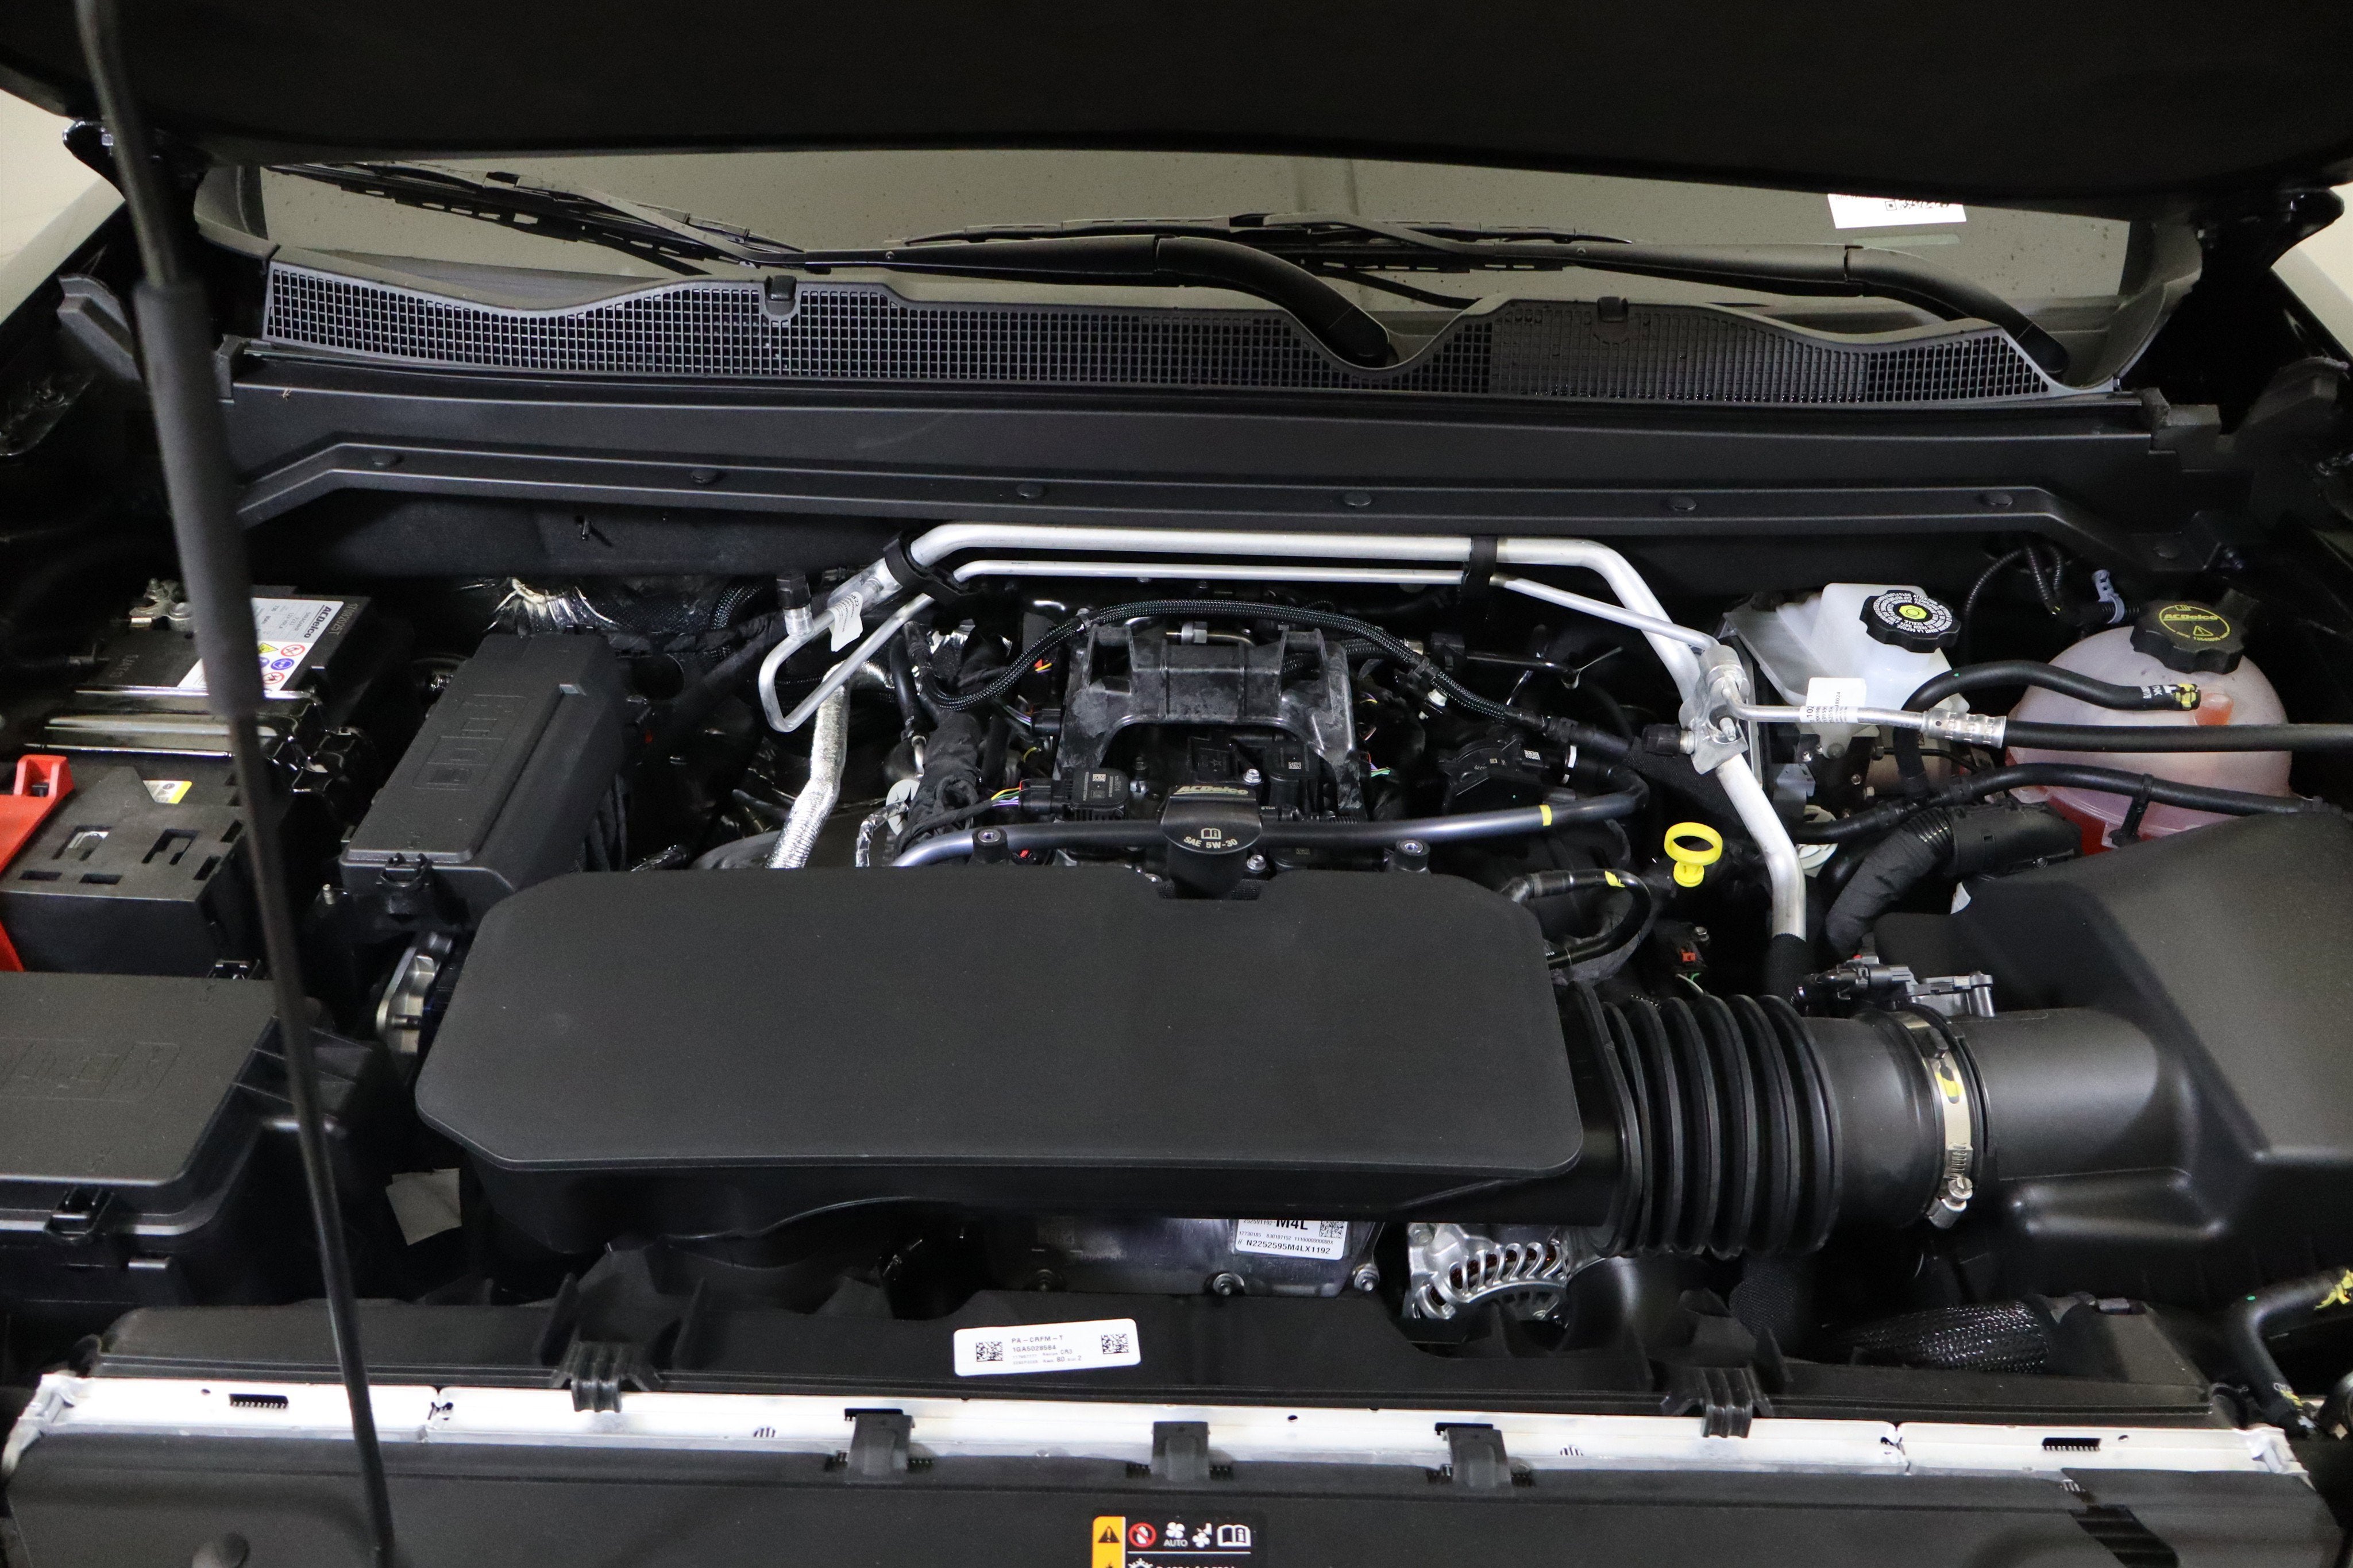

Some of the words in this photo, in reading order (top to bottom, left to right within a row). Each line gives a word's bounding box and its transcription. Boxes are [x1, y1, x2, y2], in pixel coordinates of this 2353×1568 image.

[304, 606, 332, 638] ACDelco
[1176, 786, 1249, 795] ACDelco
[1183, 836, 1202, 847] SAE
[1206, 839, 1238, 849] 5W-30
[1276, 1220, 1308, 1230] M4L
[1247, 1239, 1331, 1254] N2252595M4LX1192
[1163, 1539, 1189, 1547] AUTO
